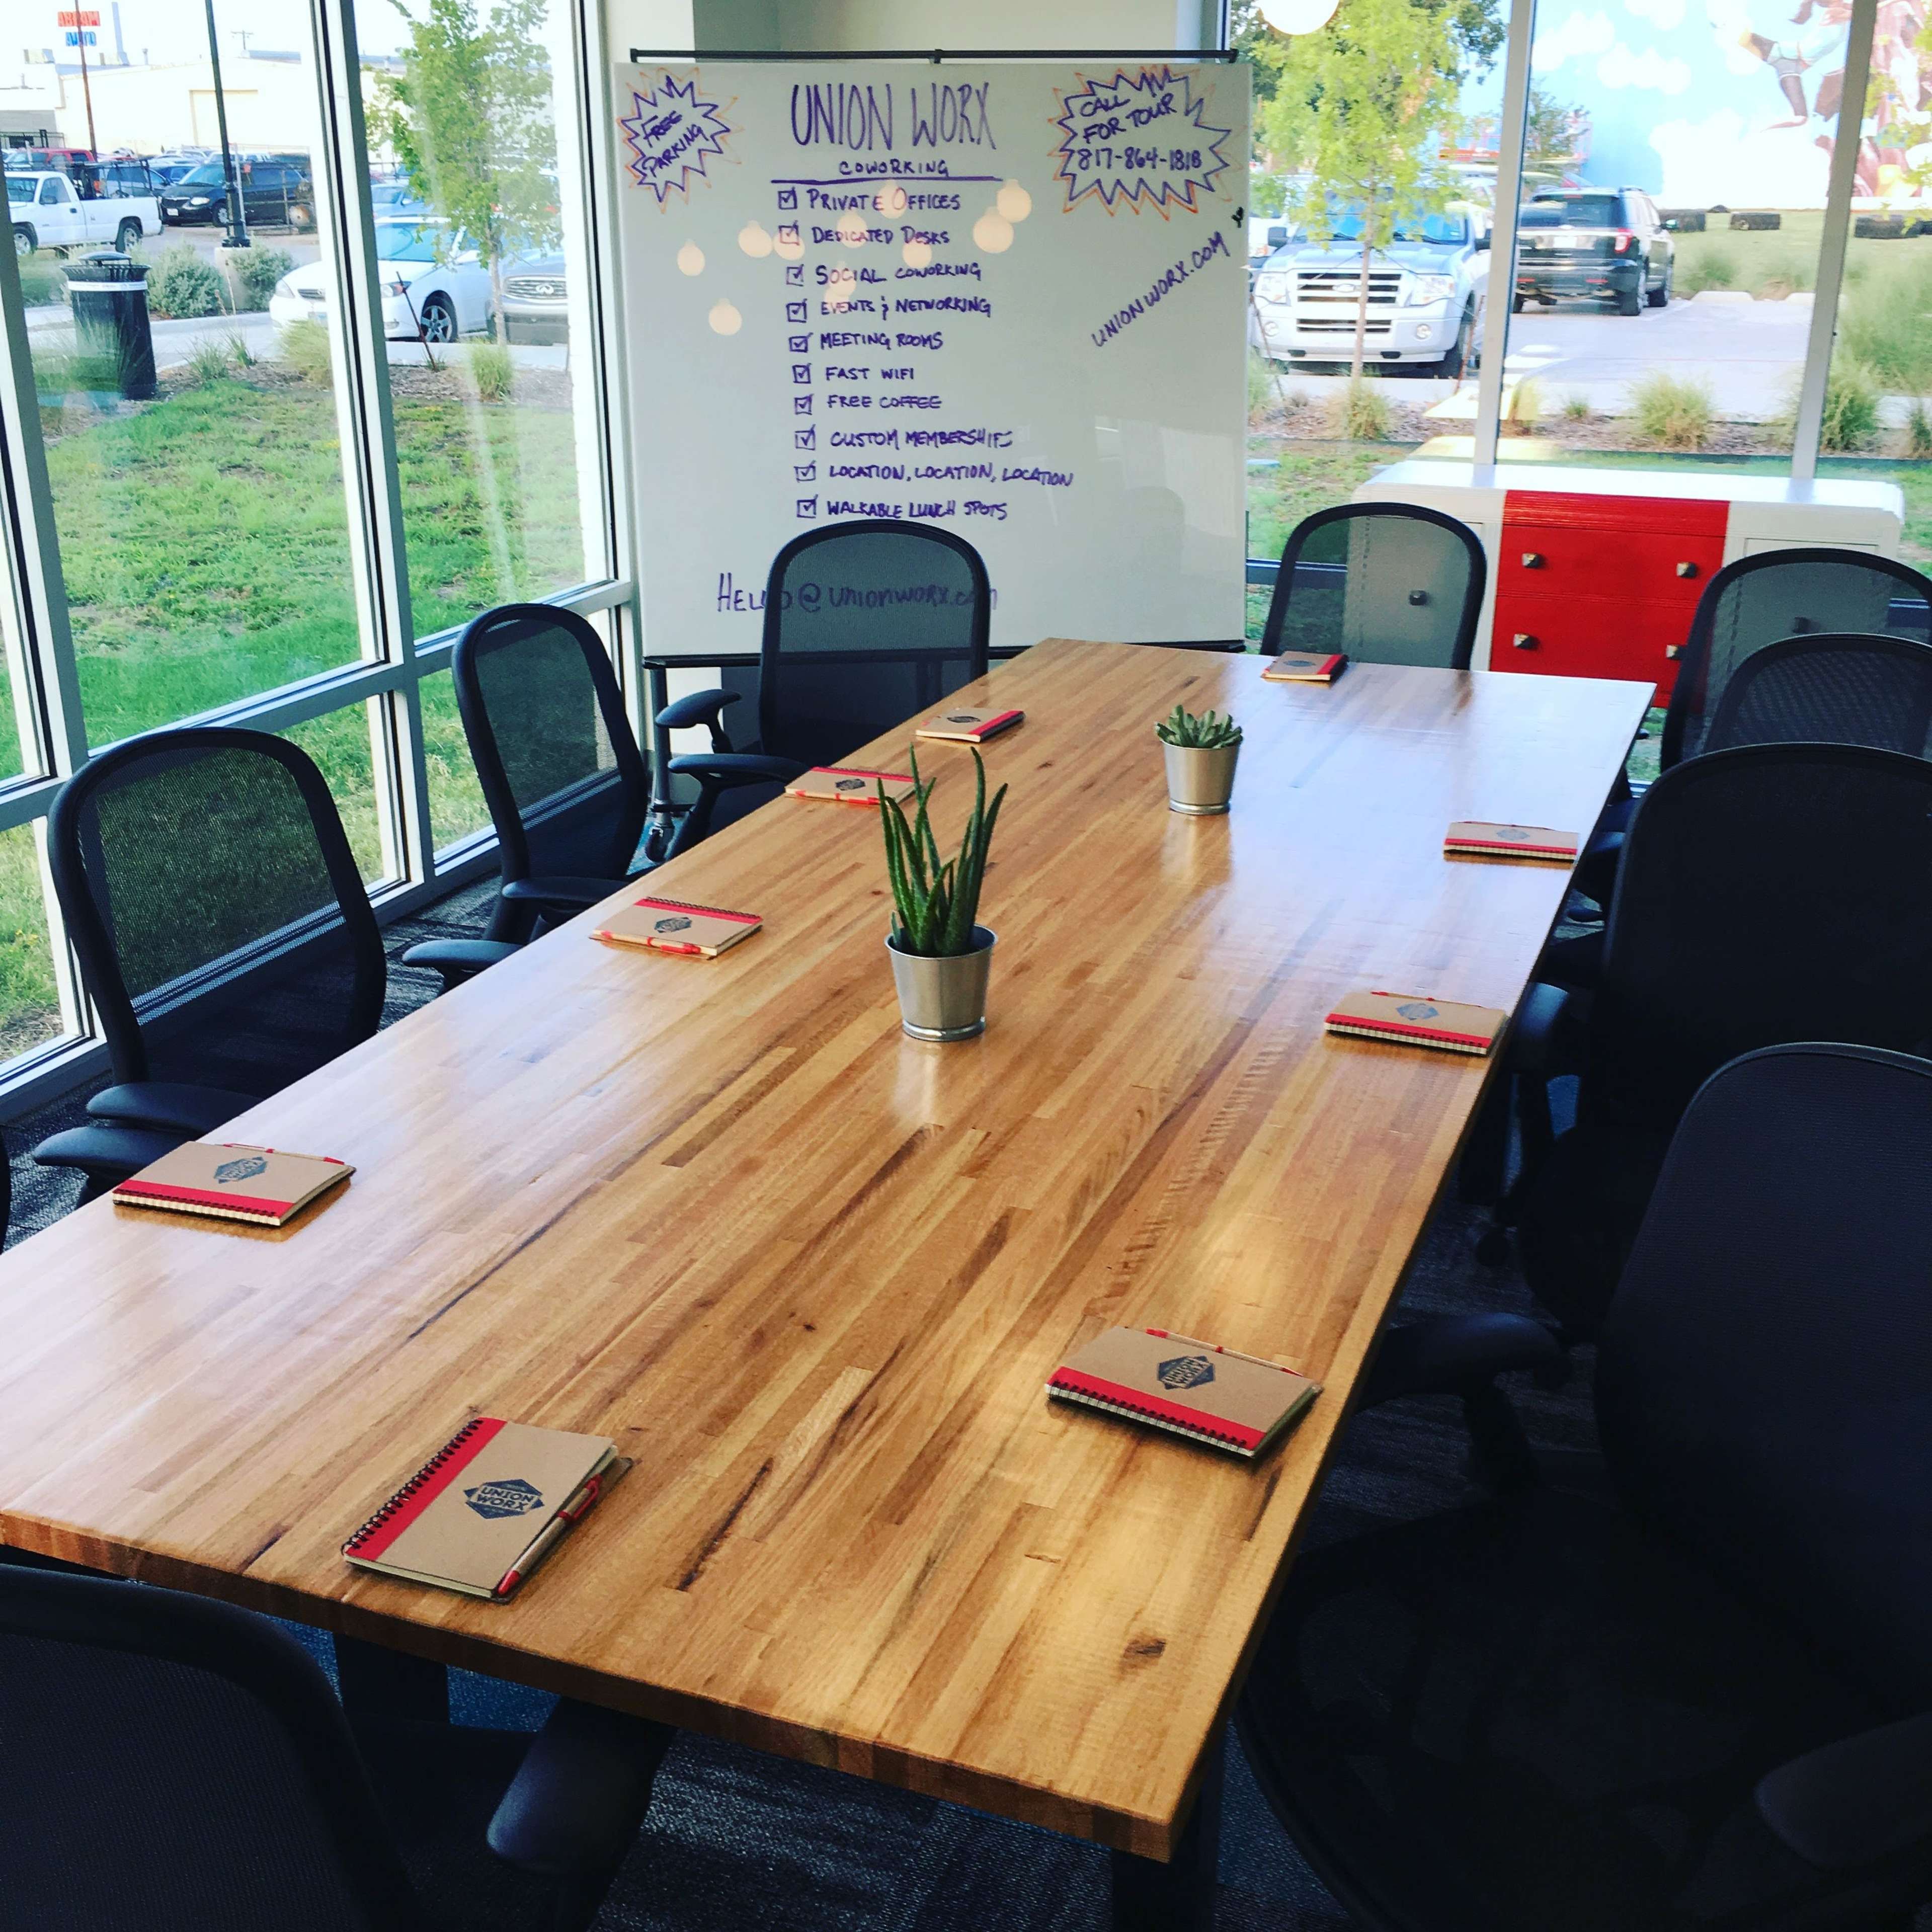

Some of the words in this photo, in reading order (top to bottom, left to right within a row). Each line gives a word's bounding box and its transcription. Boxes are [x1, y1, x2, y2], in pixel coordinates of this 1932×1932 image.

[791, 82, 893, 151] UNION
[910, 82, 996, 150] WORX
[1080, 95, 1131, 117] CALL
[642, 110, 683, 148] FREE
[1083, 116, 1127, 144] FOR
[1125, 93, 1177, 127] TOUR
[641, 124, 710, 178] PARKING
[1077, 146, 1202, 171] 817-864-1818
[839, 159, 949, 178] COWORKING
[806, 188, 884, 211] PRIVATE
[892, 187, 961, 210] OFFICES
[812, 226, 894, 245] DEDICATED
[816, 264, 888, 285] SOCIAL
[894, 262, 982, 282] COWORKING
[821, 299, 875, 315] EVENTS
[895, 295, 992, 318] NETWORKING
[820, 332, 892, 351] MEETING
[896, 331, 944, 350] ROOMS
[825, 366, 870, 381] FAST
[880, 367, 914, 380] WIFI
[827, 394, 873, 409] FREE
[879, 395, 942, 409] COFFEE
[830, 428, 900, 451] CUSTOM
[1001, 467, 1074, 487] LOCATION
[828, 500, 903, 519] WALKABLE
[909, 500, 956, 518] LUNCH
[963, 500, 1008, 521] SPOTS
[477, 1493, 529, 1511] WORX
[480, 1486, 535, 1503] UNION
